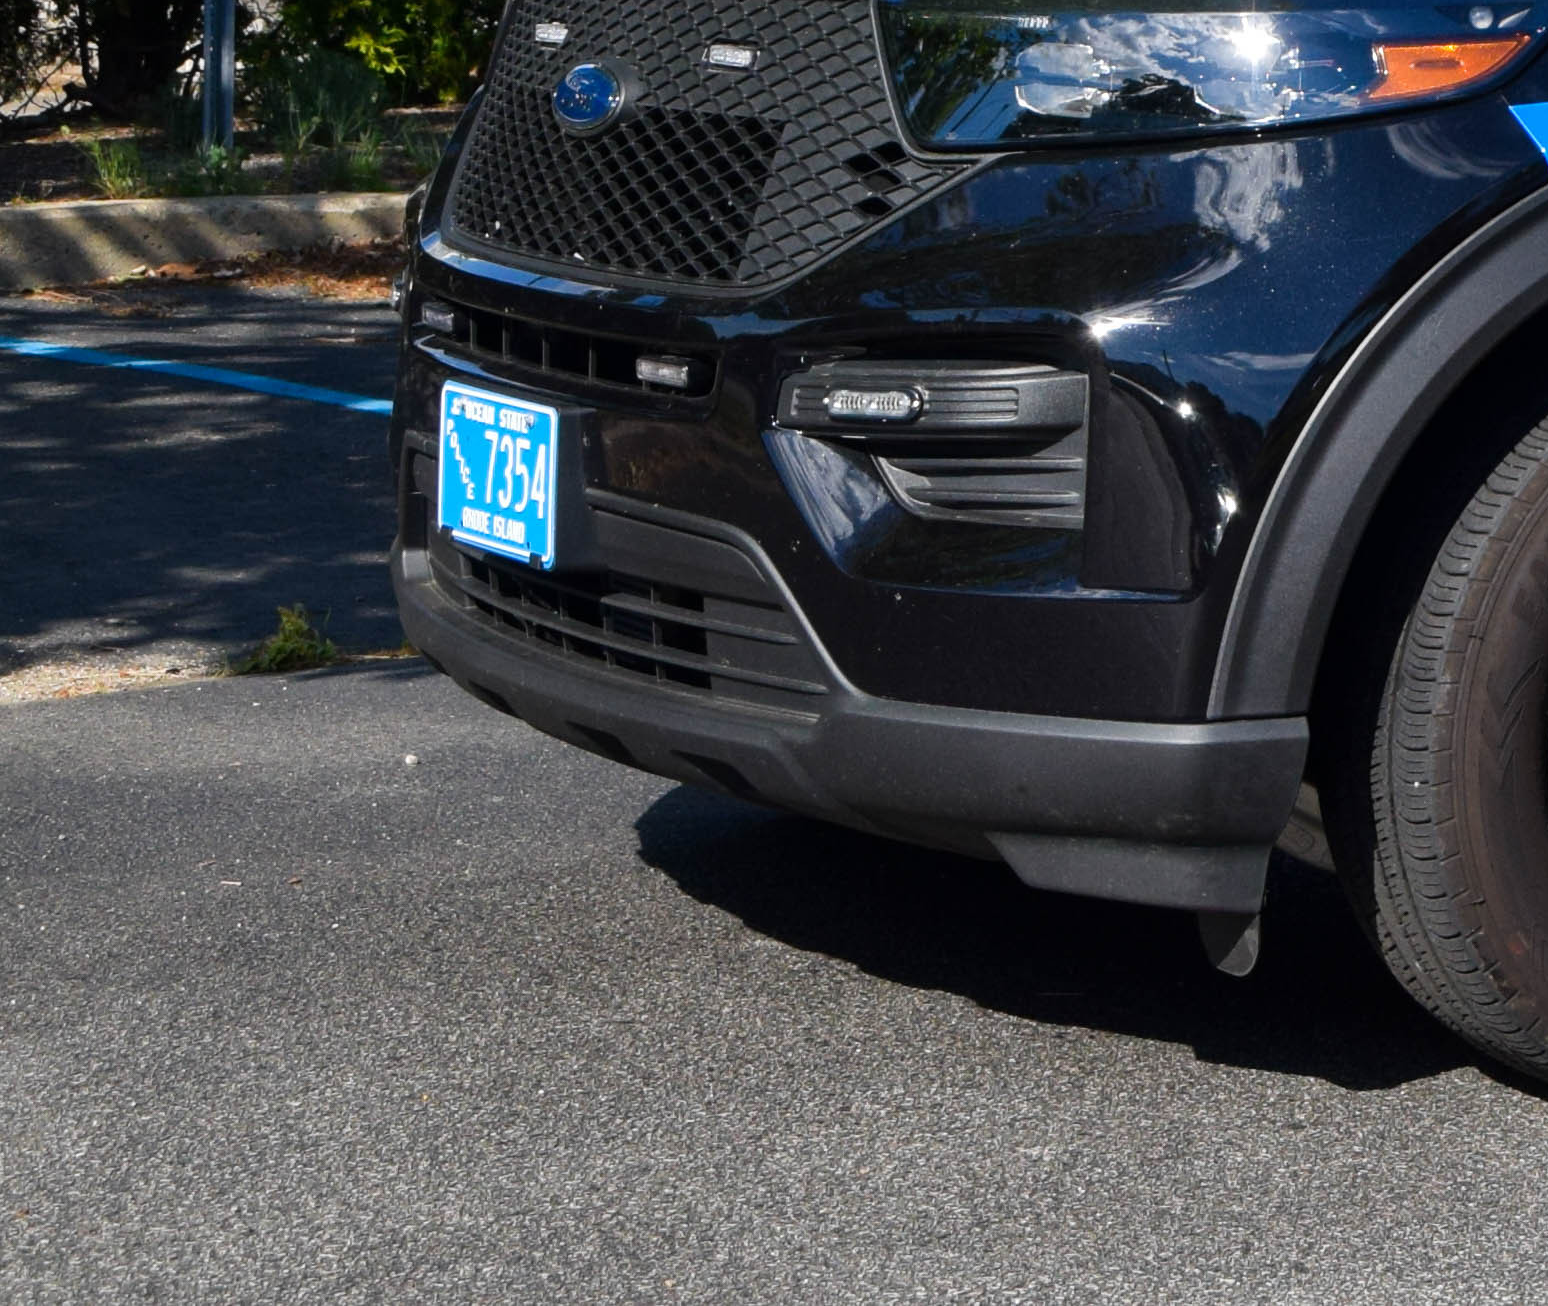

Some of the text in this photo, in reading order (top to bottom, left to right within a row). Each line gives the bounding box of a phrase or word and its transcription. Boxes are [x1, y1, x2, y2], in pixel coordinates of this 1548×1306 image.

[465, 399, 529, 434] OCEAN STATE
[446, 419, 476, 500] POLICE
[484, 430, 546, 519] 7354
[462, 507, 525, 544] RHODE ISLAND
